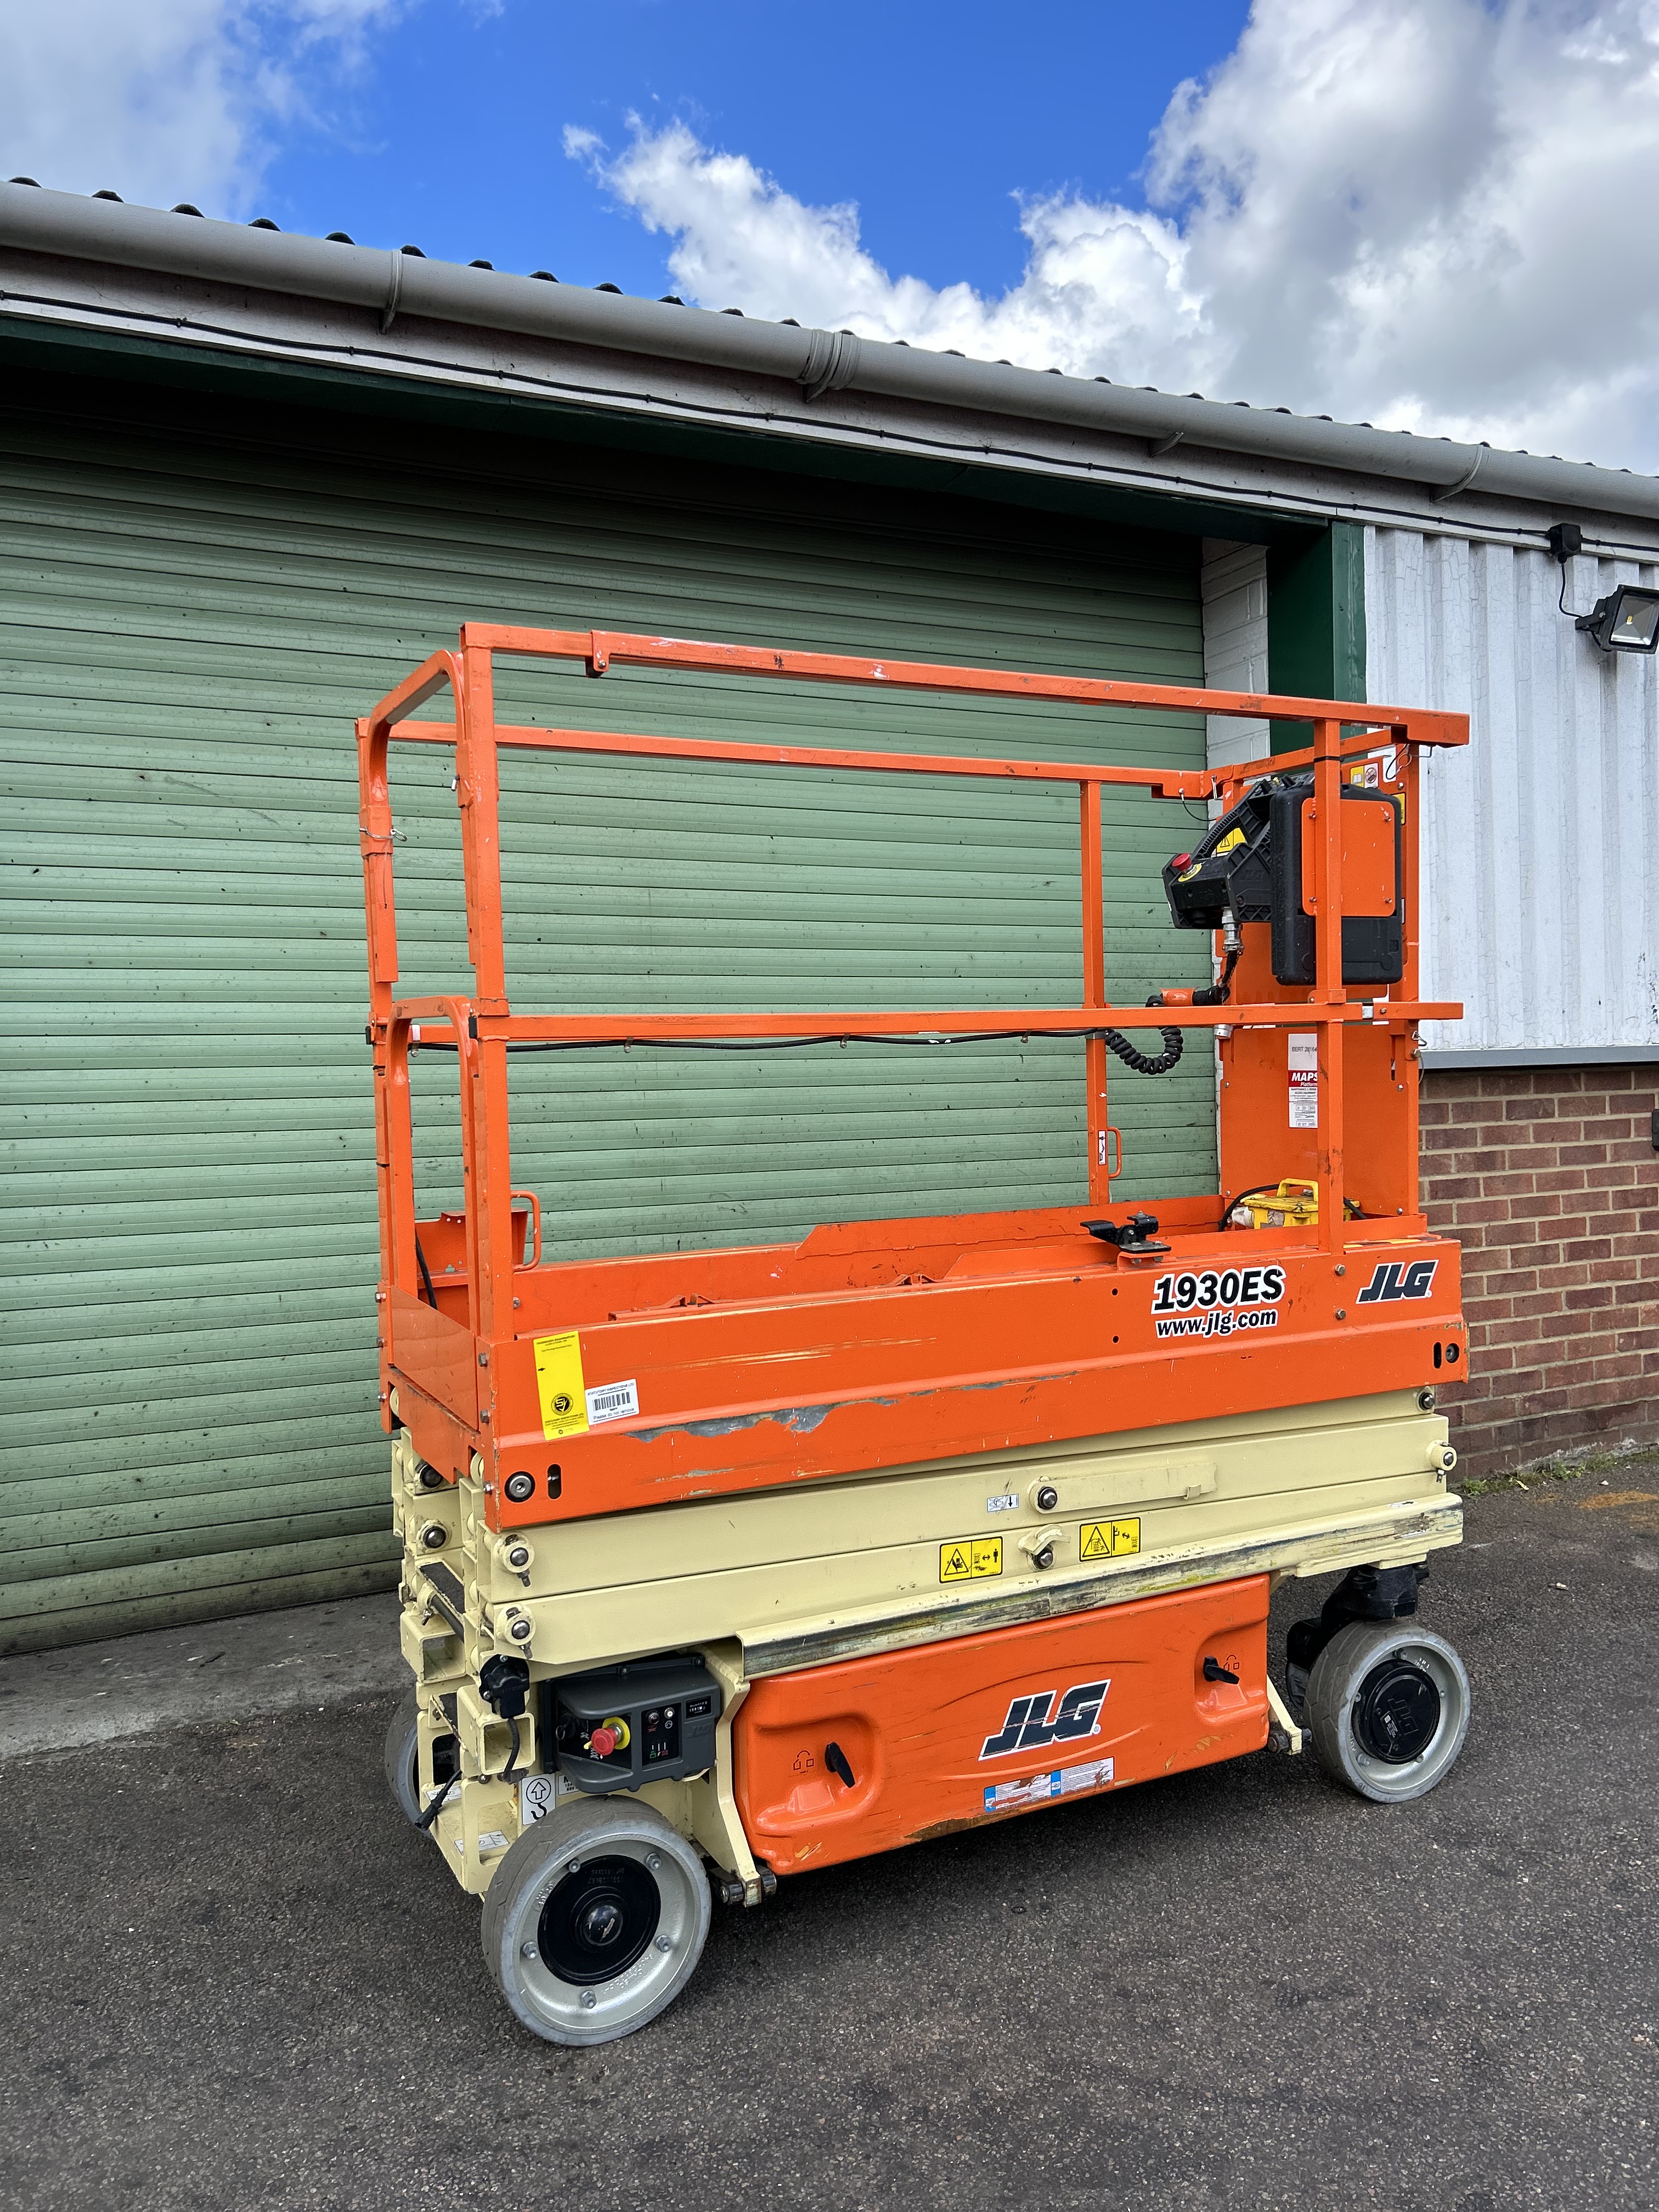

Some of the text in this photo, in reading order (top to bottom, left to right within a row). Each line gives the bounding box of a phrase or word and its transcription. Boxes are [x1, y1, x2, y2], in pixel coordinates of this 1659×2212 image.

[1153, 1267, 1283, 1312] 1930ES
[1357, 1261, 1437, 1303] JLG
[1156, 1310, 1277, 1336] www.jlg.com
[686, 1723, 713, 1739] JLG
[981, 1681, 1109, 1758] JLG
[1387, 1699, 1419, 1736] JLG
